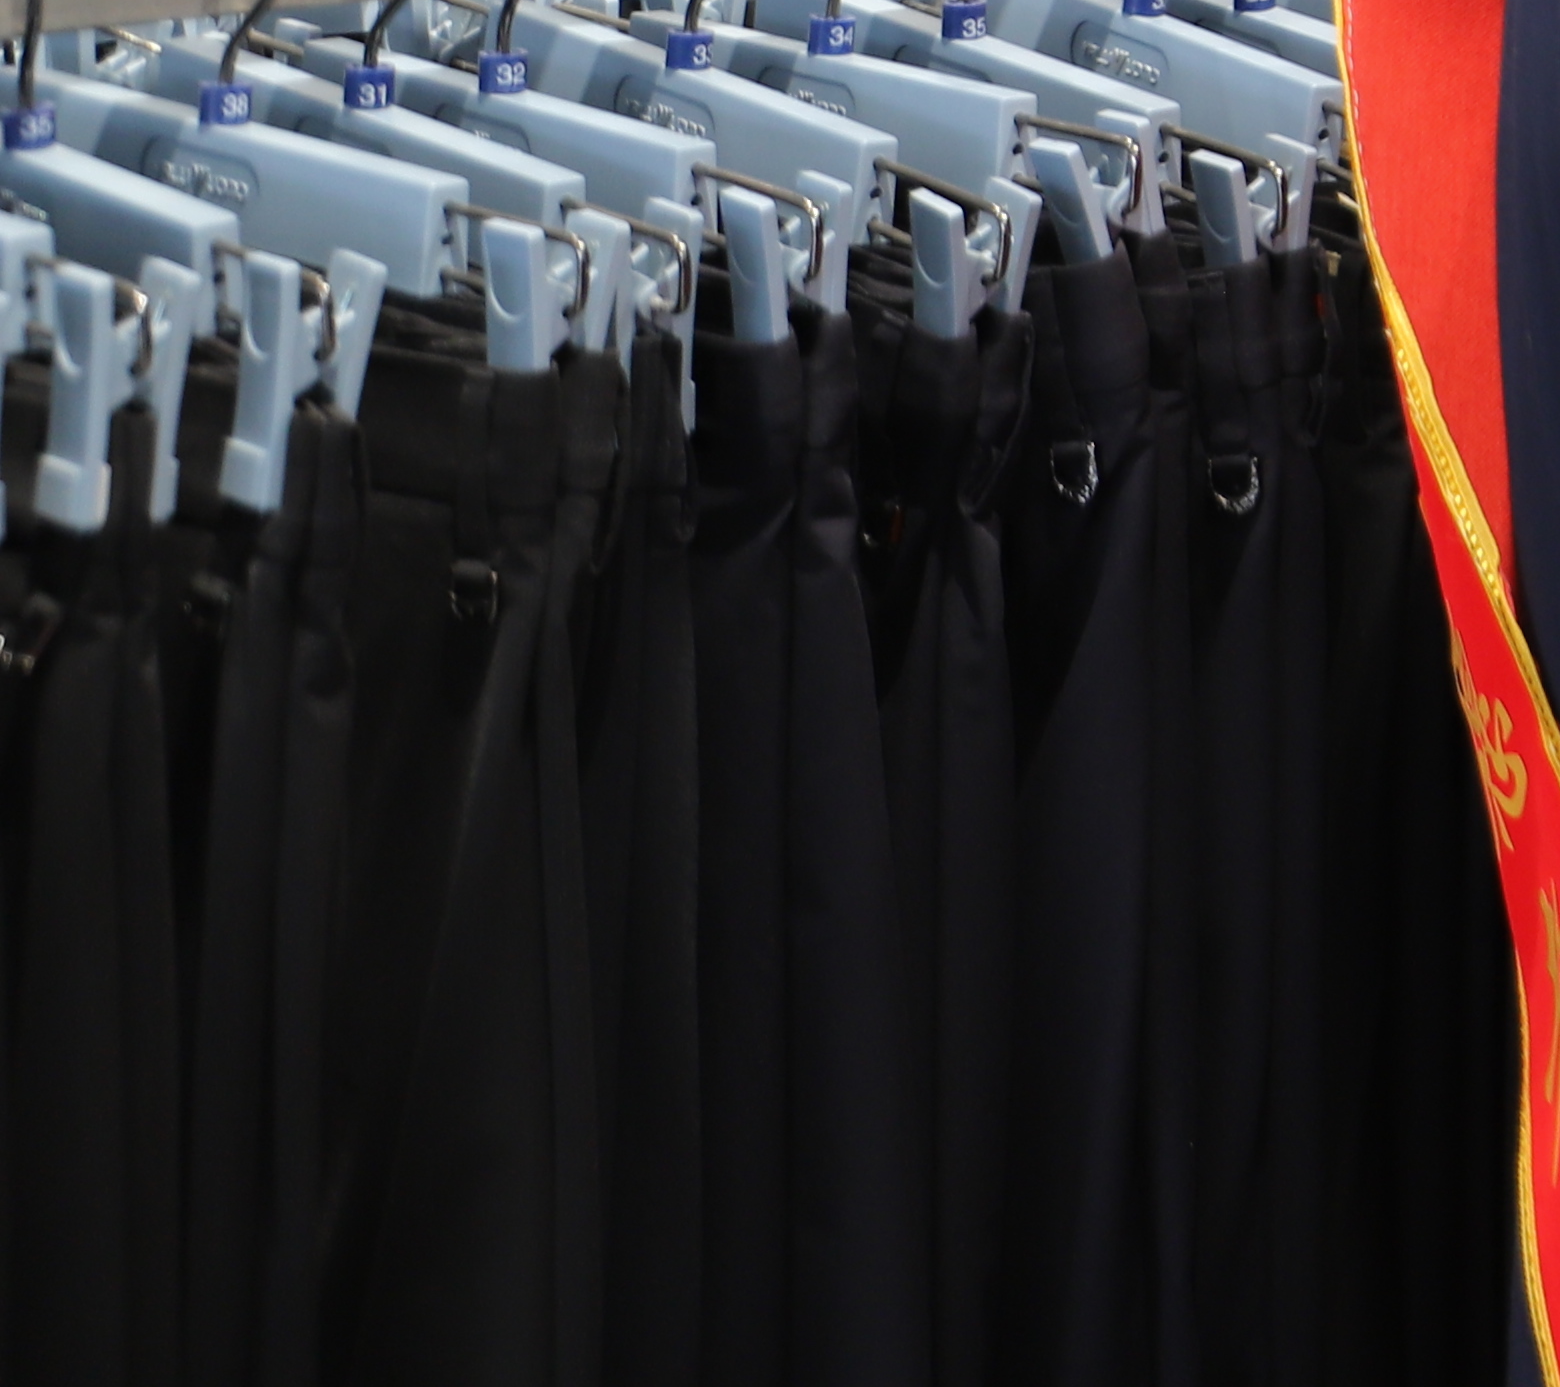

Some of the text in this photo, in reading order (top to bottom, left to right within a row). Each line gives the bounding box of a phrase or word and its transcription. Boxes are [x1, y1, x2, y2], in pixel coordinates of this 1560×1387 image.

[829, 25, 854, 47] 34
[962, 18, 986, 39] 35
[496, 61, 527, 85] 32
[358, 82, 387, 107] 31
